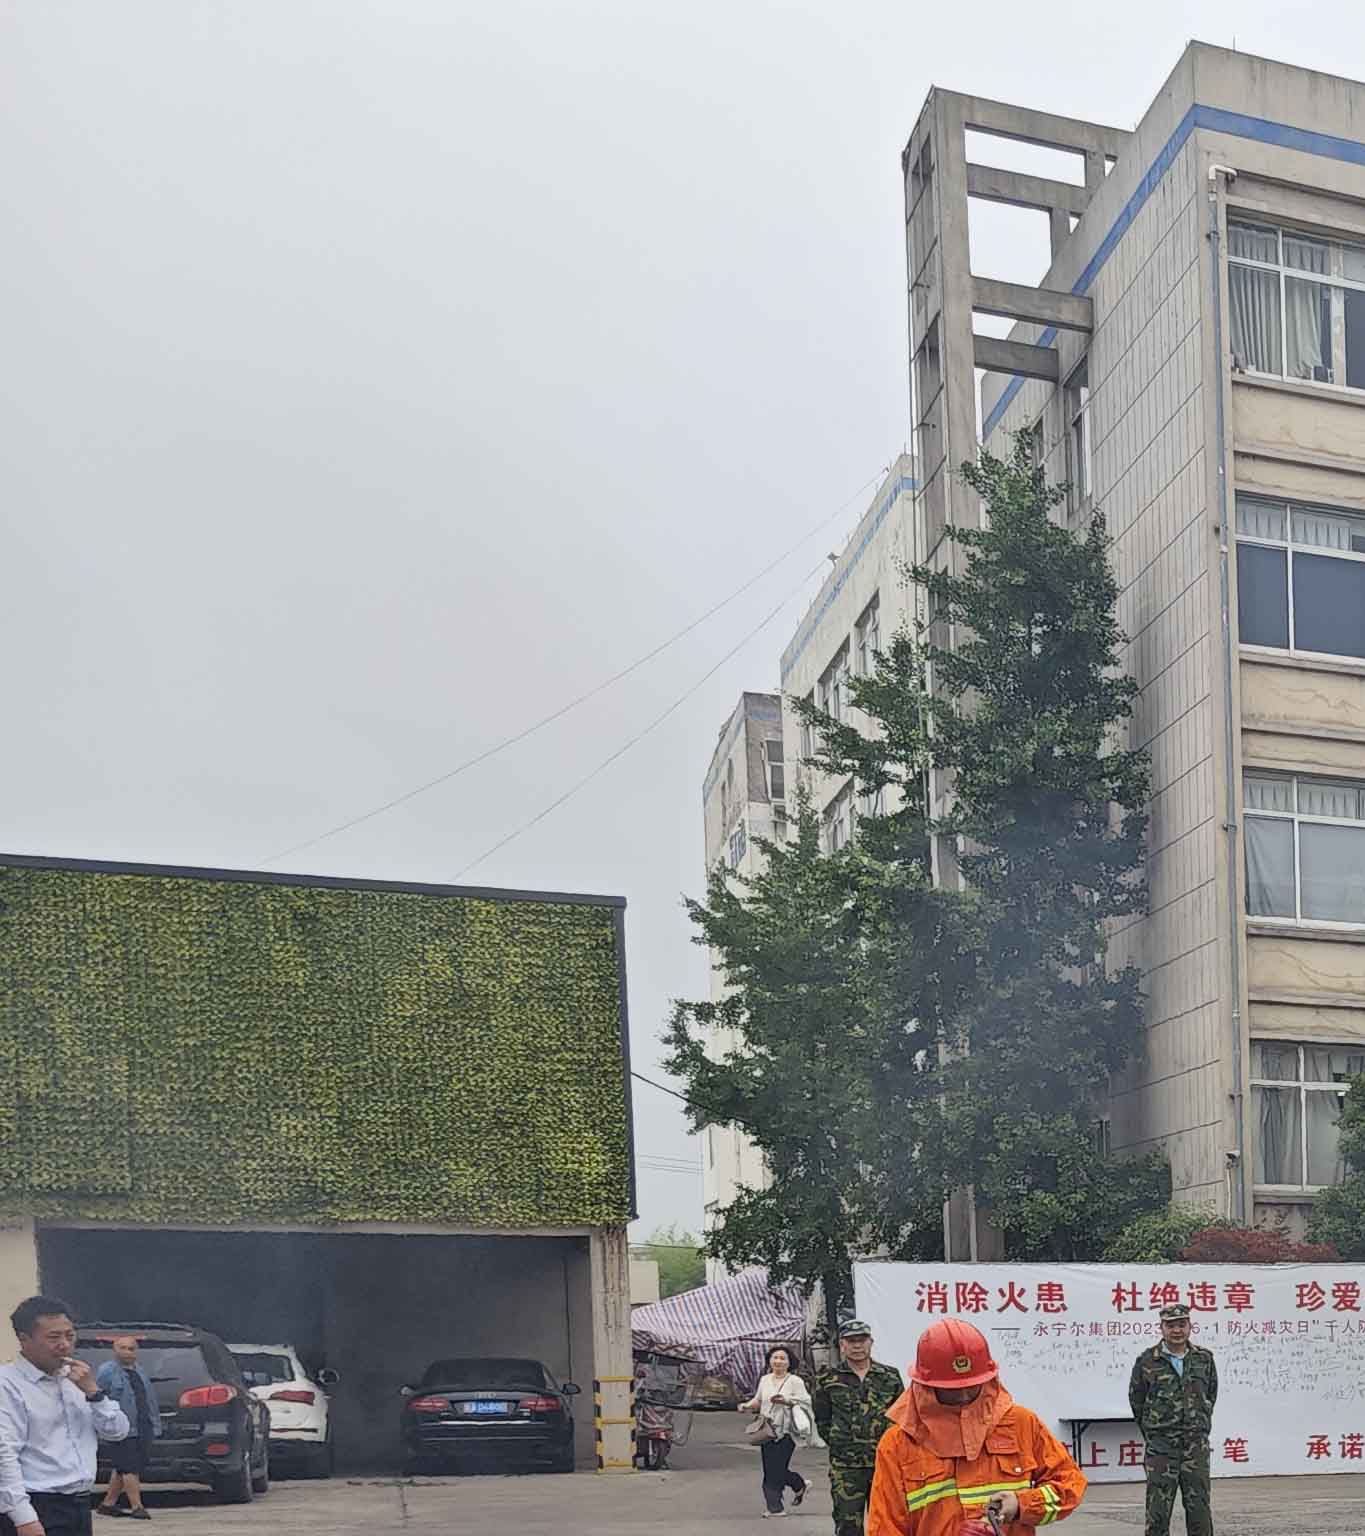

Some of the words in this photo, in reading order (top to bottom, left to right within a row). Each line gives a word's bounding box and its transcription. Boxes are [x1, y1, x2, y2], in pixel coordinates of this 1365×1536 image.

[915, 1281, 1068, 1313] 消除火患
[1112, 1281, 1256, 1313] 杜绝违章
